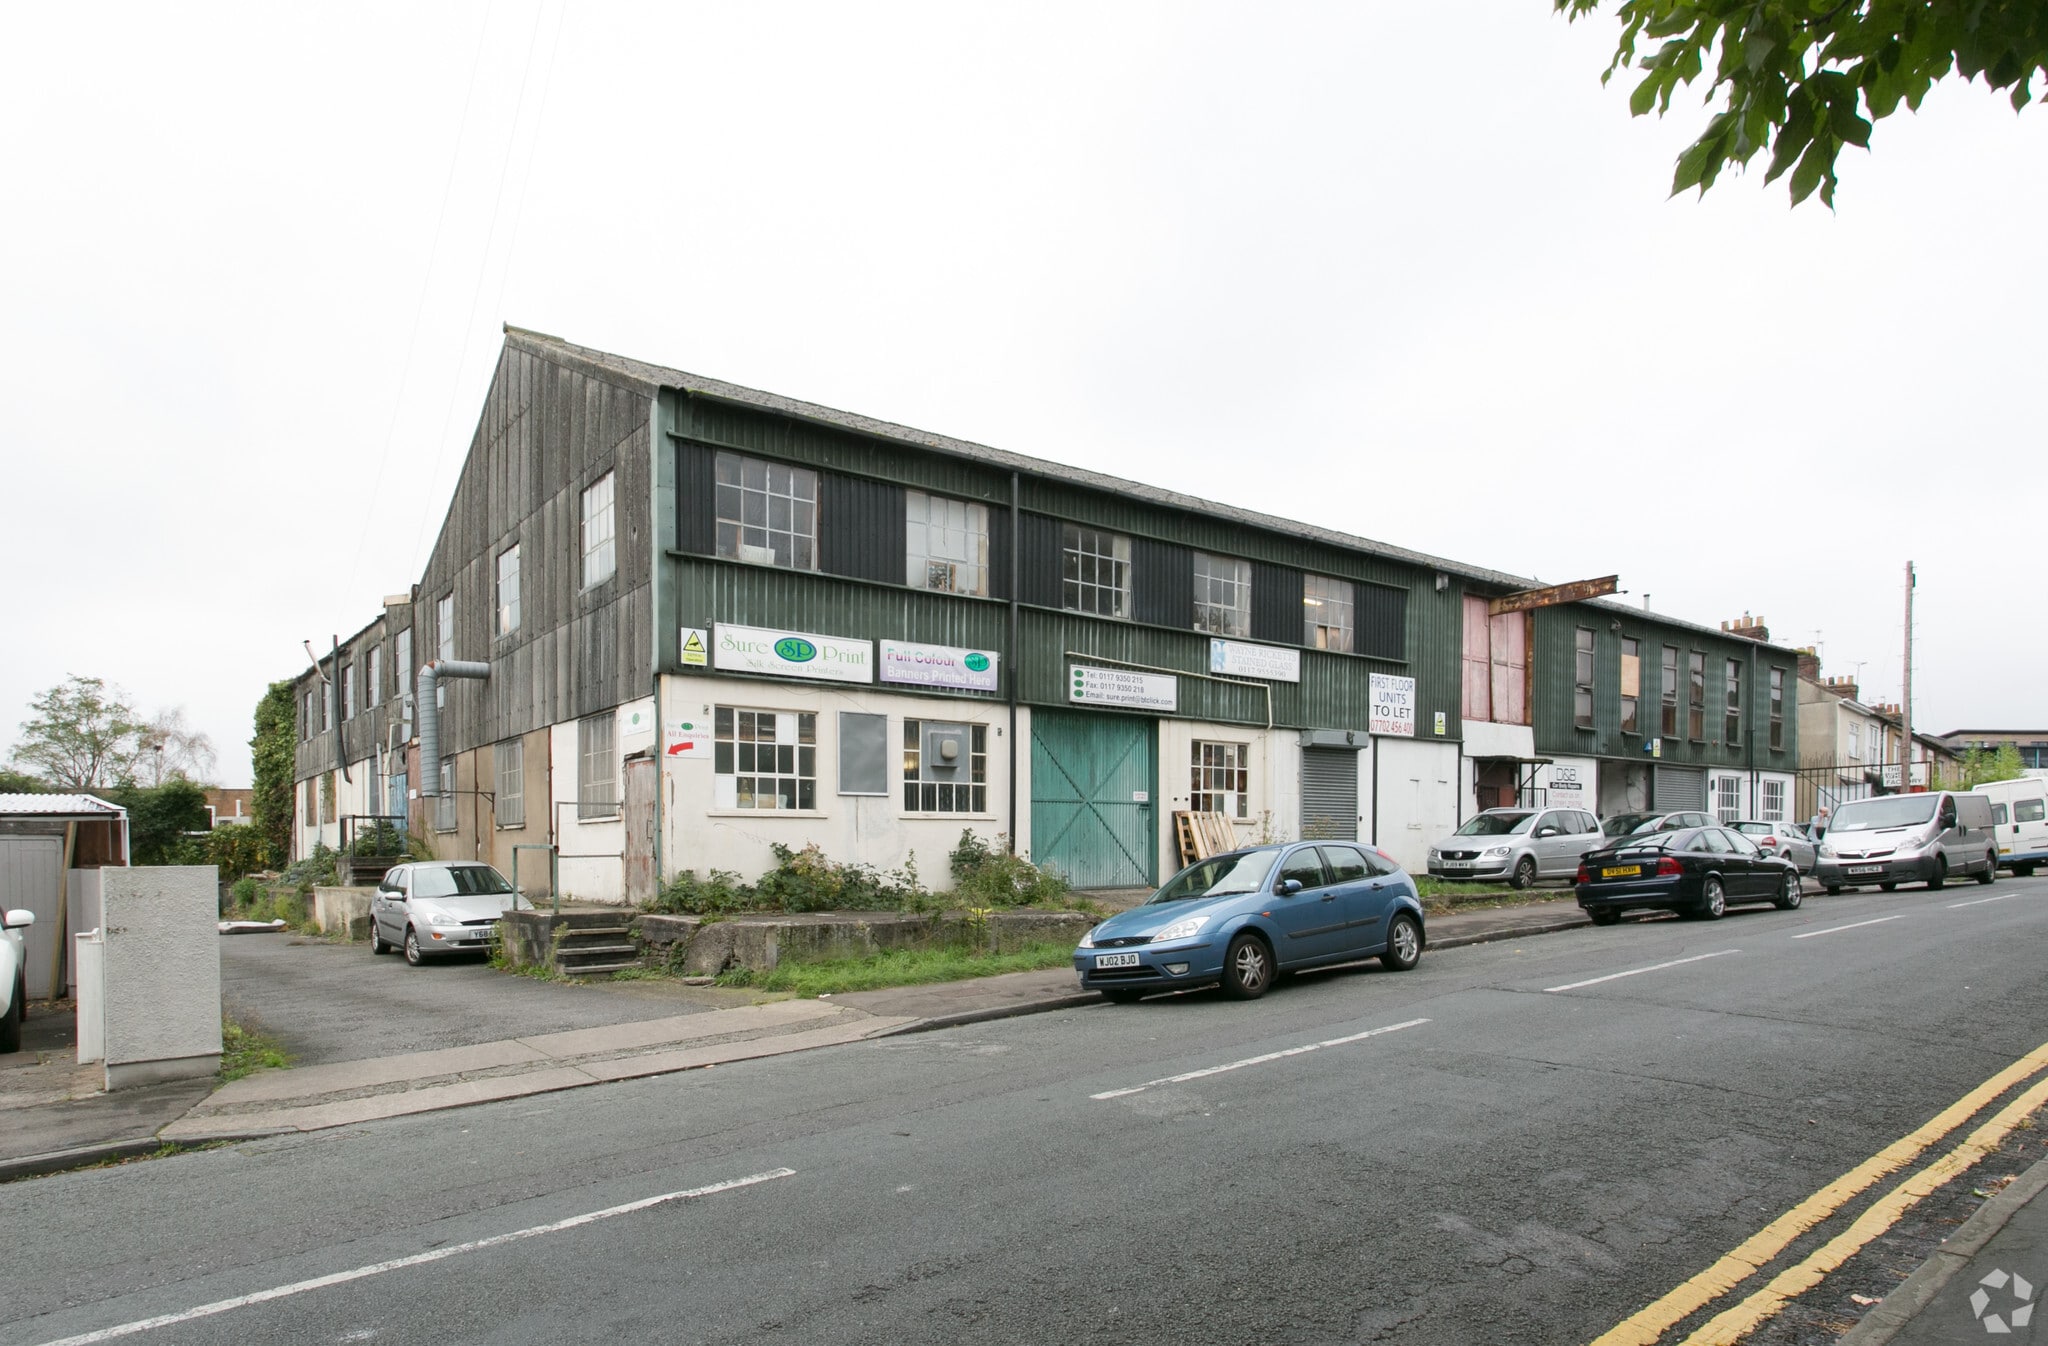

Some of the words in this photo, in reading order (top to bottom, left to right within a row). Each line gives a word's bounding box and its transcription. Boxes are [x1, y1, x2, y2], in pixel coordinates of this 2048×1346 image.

[721, 634, 768, 654] Sure
[781, 641, 812, 657] SP
[823, 646, 865, 664] Print
[1228, 644, 1256, 656] WAYNE
[1259, 649, 1296, 662] RICKETTS
[887, 648, 910, 662] Full
[915, 651, 954, 666] Colour
[1232, 655, 1266, 668] STAINED
[1268, 659, 1292, 671] GLASS
[746, 658, 764, 669] Silk
[768, 661, 803, 672] Screen
[806, 664, 844, 676] Printers
[887, 666, 929, 680] Banners
[932, 670, 966, 684] Printed
[969, 674, 990, 686] Here
[1099, 672, 1114, 681] 0117
[1115, 674, 1130, 683] 9350
[1132, 676, 1143, 684] 215
[1086, 681, 1098, 689] Fax:
[1100, 682, 1115, 690] 0117
[1117, 684, 1131, 692] 9350
[1371, 676, 1389, 689] FIRST
[1392, 679, 1413, 691] FLOOR
[1086, 691, 1104, 699] Email:
[1379, 692, 1406, 704] UNITS
[1374, 705, 1390, 716] TO
[1394, 707, 1411, 718] LET
[1371, 720, 1390, 732] 07702
[1391, 721, 1402, 733] 456
[679, 731, 709, 739] Enquiries
[1557, 768, 1576, 781] D&B
[1099, 956, 1119, 966] WJ02
[1120, 955, 1136, 965] BJO
